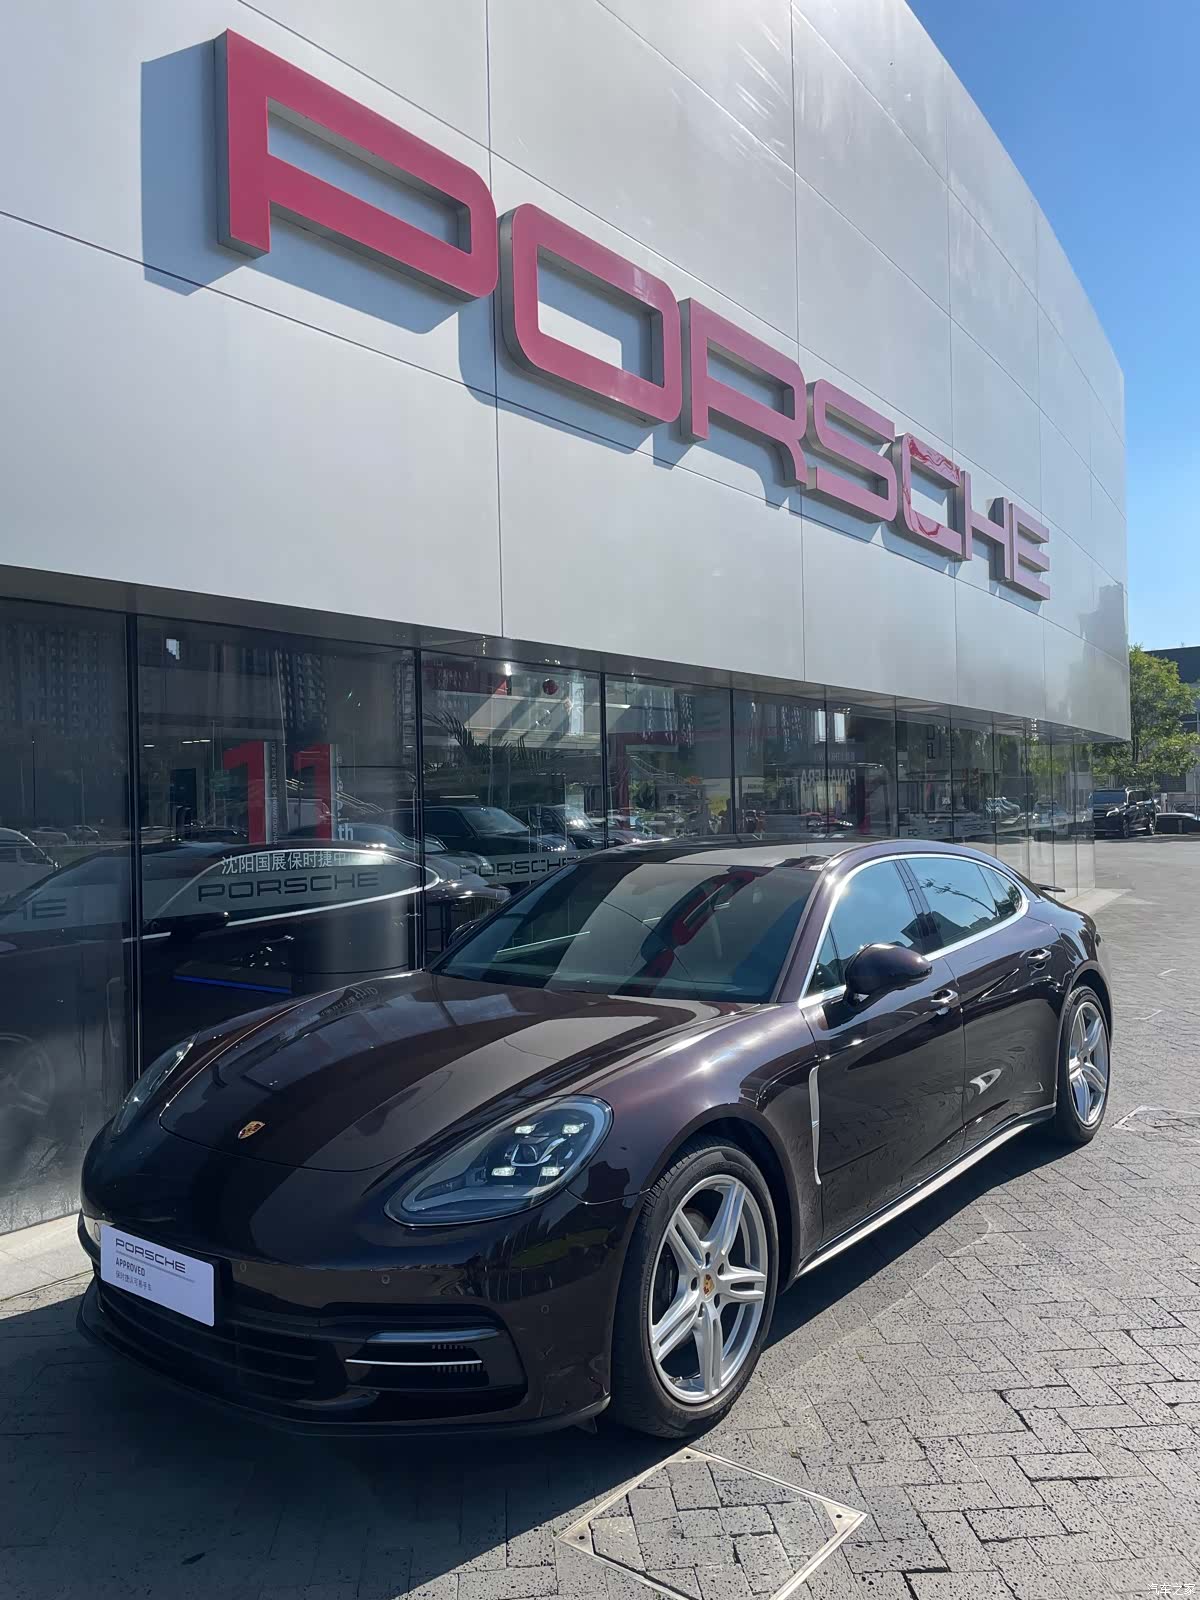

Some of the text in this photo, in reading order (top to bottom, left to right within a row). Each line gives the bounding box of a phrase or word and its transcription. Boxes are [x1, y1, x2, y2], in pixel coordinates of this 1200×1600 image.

[214, 28, 1050, 600] PORSCHE
[221, 851, 357, 875] 沈阳国展保时捷中
[198, 871, 379, 902] PORSCHE
[115, 1238, 186, 1274] PORSCHE
[115, 1257, 146, 1277] APPROVED
